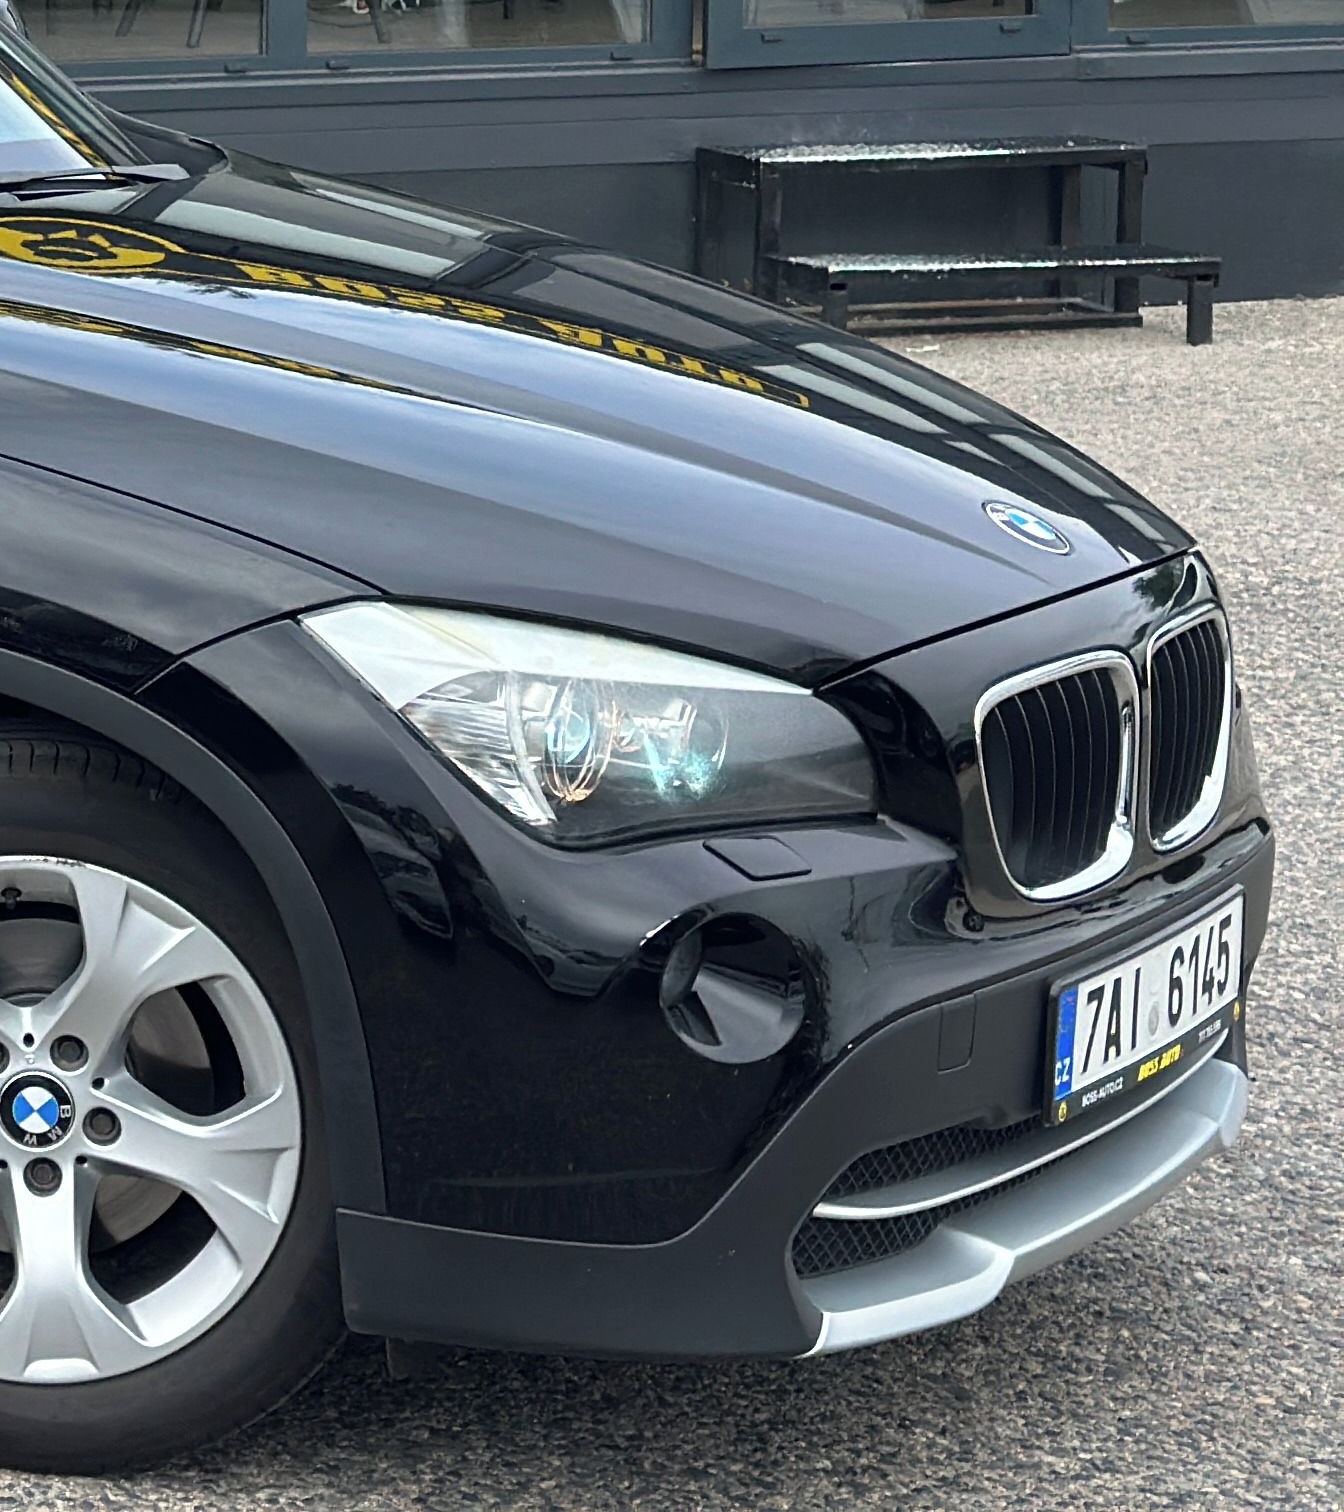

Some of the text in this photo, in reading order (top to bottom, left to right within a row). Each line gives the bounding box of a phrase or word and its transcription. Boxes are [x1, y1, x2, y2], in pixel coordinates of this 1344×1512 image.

[1080, 913, 1232, 1076] 7AI 6145
[1054, 1056, 1070, 1086] CZ
